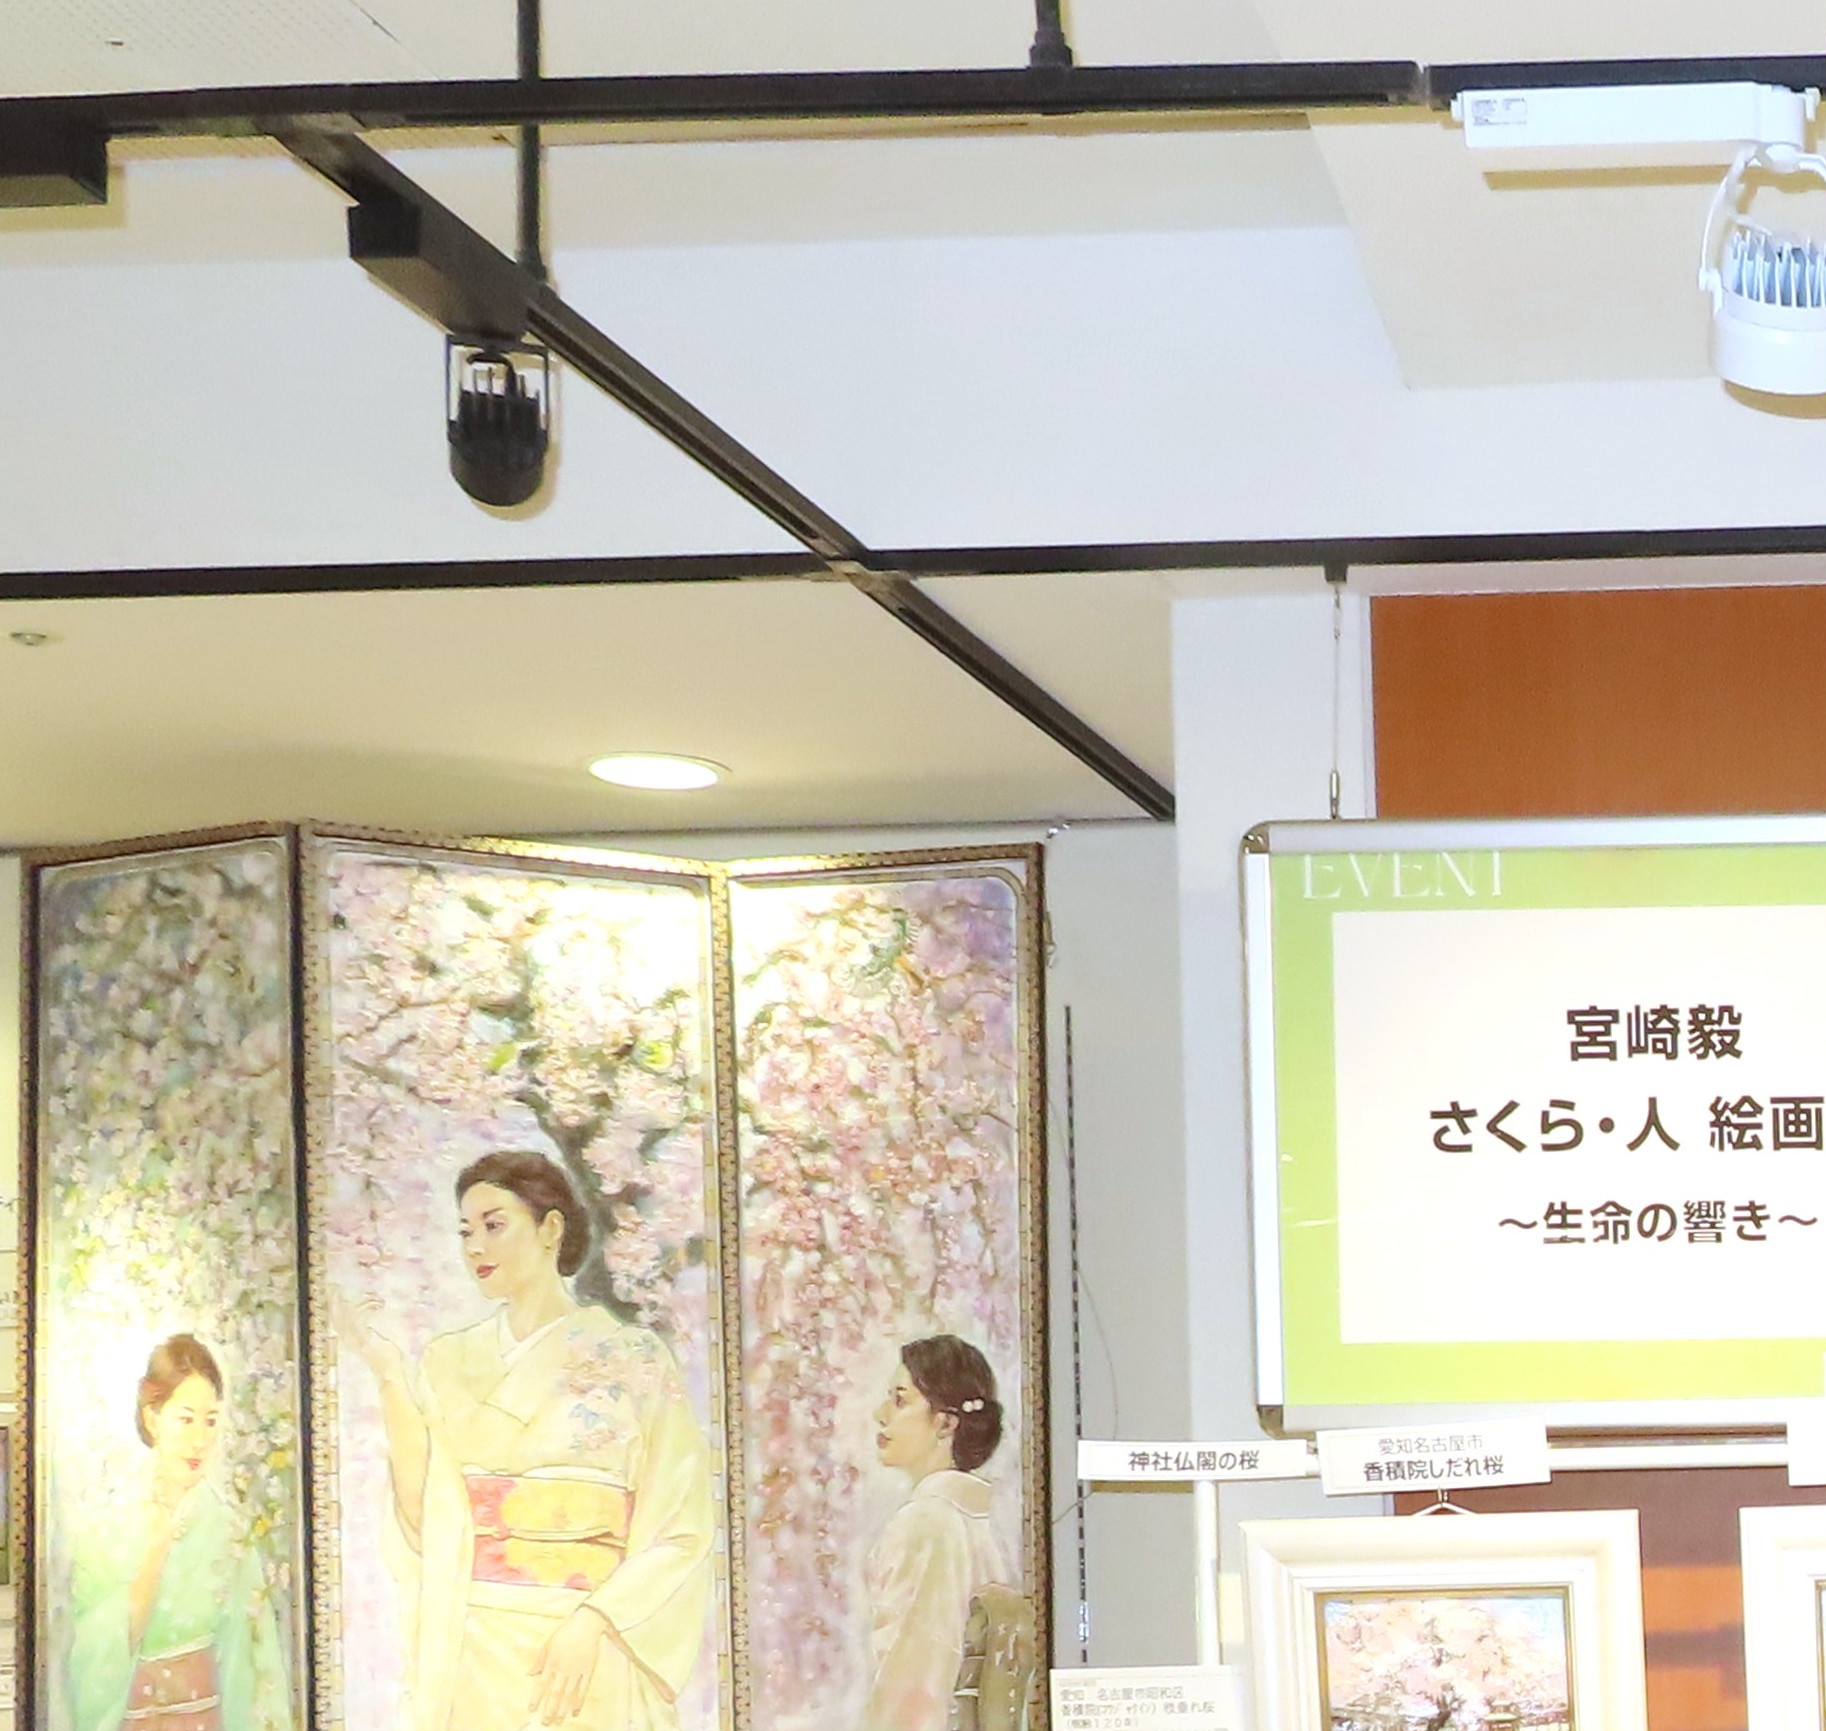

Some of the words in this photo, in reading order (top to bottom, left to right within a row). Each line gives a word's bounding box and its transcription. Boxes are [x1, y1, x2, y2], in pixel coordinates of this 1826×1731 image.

[1303, 851, 1502, 898] EVENT
[1567, 1005, 1744, 1062] 宮崎毅
[1378, 1434, 1484, 1455] 愛知名古屋市
[1128, 1450, 1260, 1473] 神社仏閣の桜
[1363, 1455, 1505, 1482] 香積院しだれ桜
